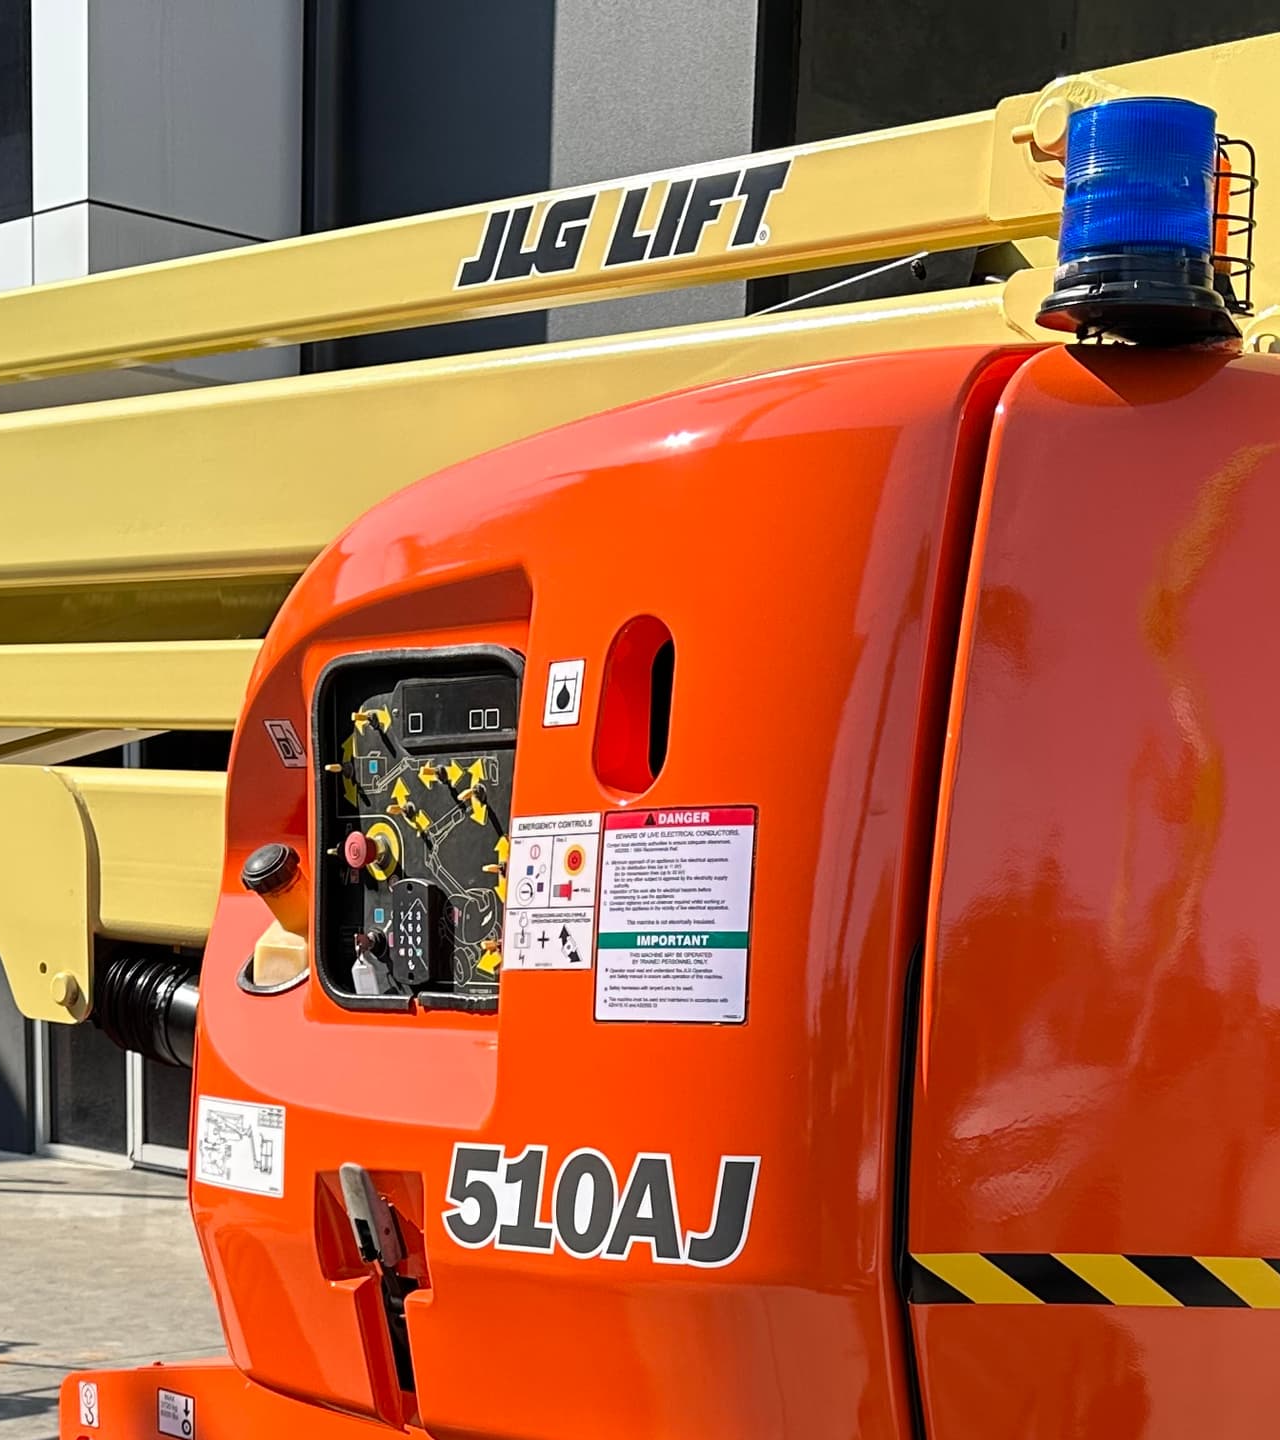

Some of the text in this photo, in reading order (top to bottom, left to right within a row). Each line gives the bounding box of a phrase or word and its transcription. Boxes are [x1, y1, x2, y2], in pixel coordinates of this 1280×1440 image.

[455, 159, 793, 289] JLG LIFT
[658, 811, 710, 824] DANGER
[518, 819, 593, 831] EMERGENCY CONTROLS
[636, 935, 709, 947] IMPORTANT
[443, 1143, 759, 1266] 510AJ
